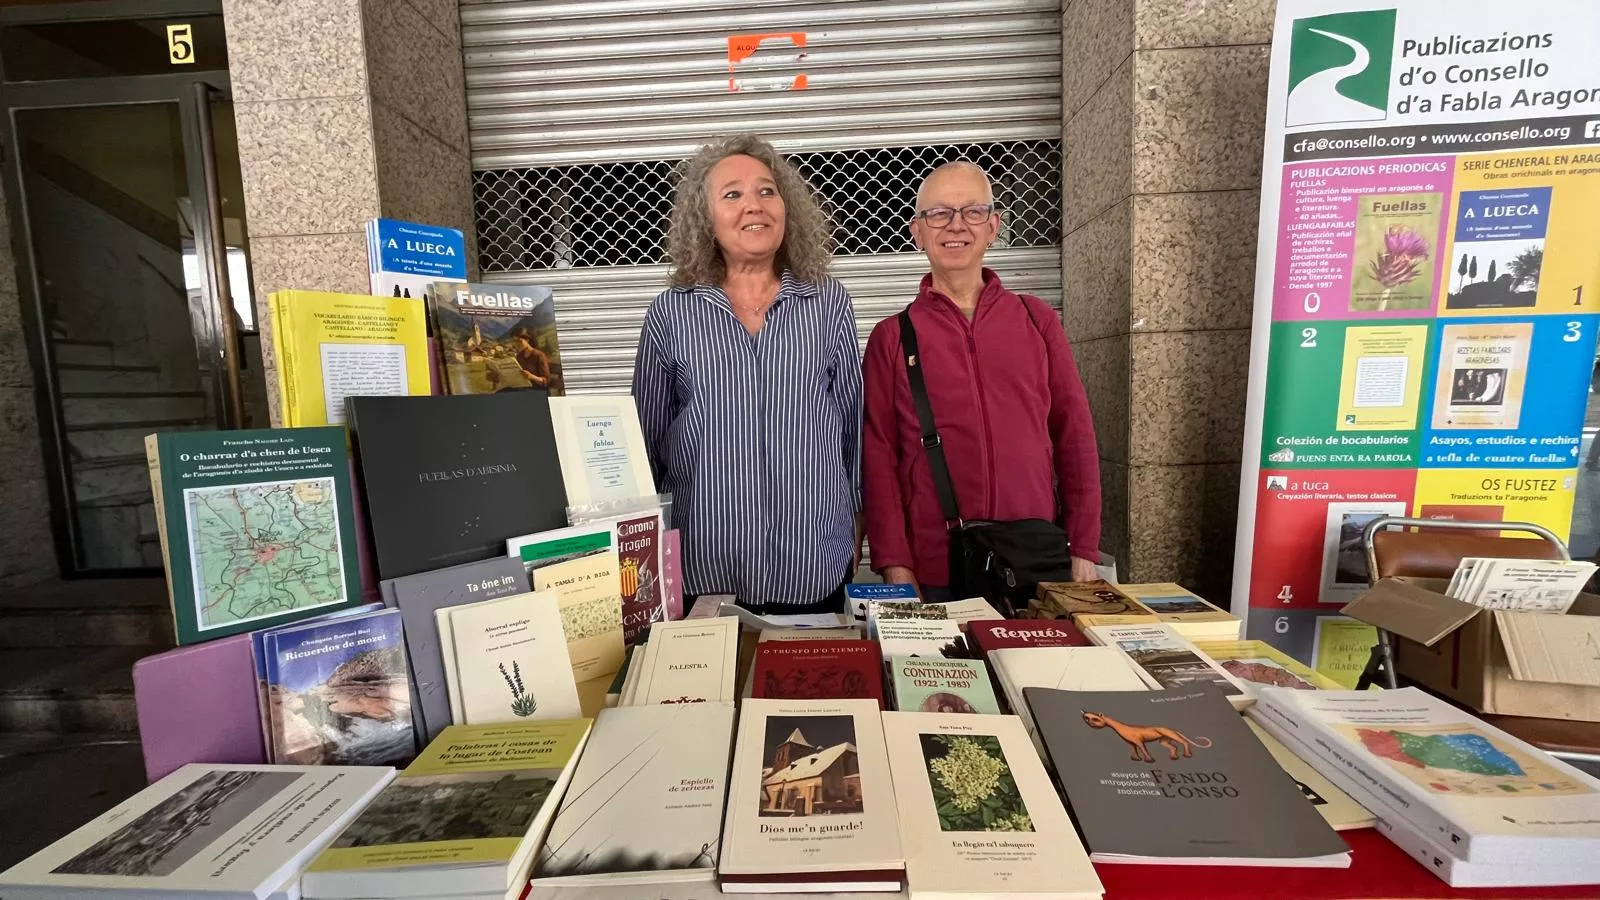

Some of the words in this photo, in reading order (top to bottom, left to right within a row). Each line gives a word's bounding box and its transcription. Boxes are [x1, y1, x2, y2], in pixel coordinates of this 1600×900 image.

[173, 28, 191, 60] 5
[1402, 31, 1553, 58] Publicazions
[1399, 67, 1437, 86] d'o
[1445, 58, 1549, 83] Consello
[1396, 95, 1431, 114] d'a
[1440, 91, 1501, 112] Fabla
[1511, 88, 1600, 110] Aragon
[1293, 134, 1415, 153] cfa@consello.org
[1431, 126, 1570, 144] www.consello.org
[1291, 165, 1375, 179] PUBLICAZIONS
[1379, 163, 1447, 174] PERIODICAS
[1463, 160, 1490, 170] SERIE
[1494, 157, 1550, 168] CHENERAL
[1554, 156, 1568, 164] EN
[1290, 180, 1326, 188] FUELLAS
[1483, 172, 1508, 180] Obras
[1341, 186, 1375, 194] bimestral
[1372, 201, 1426, 212] Fuellas
[1464, 208, 1475, 218] A
[1483, 204, 1539, 217] LUECA
[388, 238, 398, 249] A
[406, 241, 455, 256] LUECA
[457, 290, 533, 308] Fuellas
[1572, 285, 1582, 305] 1
[1300, 328, 1317, 348] 2
[1563, 322, 1582, 342] 3
[1276, 436, 1322, 445] Colezión
[1326, 436, 1338, 445] de
[1342, 435, 1408, 445] bocabularios
[1430, 436, 1472, 445] Asayos,
[1476, 436, 1526, 444] estudios
[180, 454, 190, 462] O
[193, 452, 236, 461] charrar
[241, 450, 256, 458] d'a
[260, 449, 284, 457] chen
[303, 446, 331, 454] Uesca
[1374, 454, 1412, 462] PAROLA
[1466, 453, 1480, 462] de
[1484, 455, 1524, 463] cuatro
[1303, 481, 1328, 490] tuca
[1482, 478, 1500, 491] OS
[1505, 479, 1557, 491] FUSTEZ
[466, 584, 478, 592] Ta
[482, 580, 499, 589] óne
[501, 576, 514, 584] im
[1277, 585, 1293, 603] 4
[1275, 617, 1289, 633] 6
[989, 627, 1068, 641] Repués
[285, 643, 340, 661] Ricuerdos
[342, 640, 355, 648] de
[357, 634, 387, 645] mozet
[903, 668, 978, 679] CONTINAZION
[680, 778, 713, 786] Espiello
[1151, 769, 1227, 786] FENDO
[760, 824, 784, 833] Dios
[788, 824, 815, 833] me'n
[820, 821, 863, 834] guarde!
